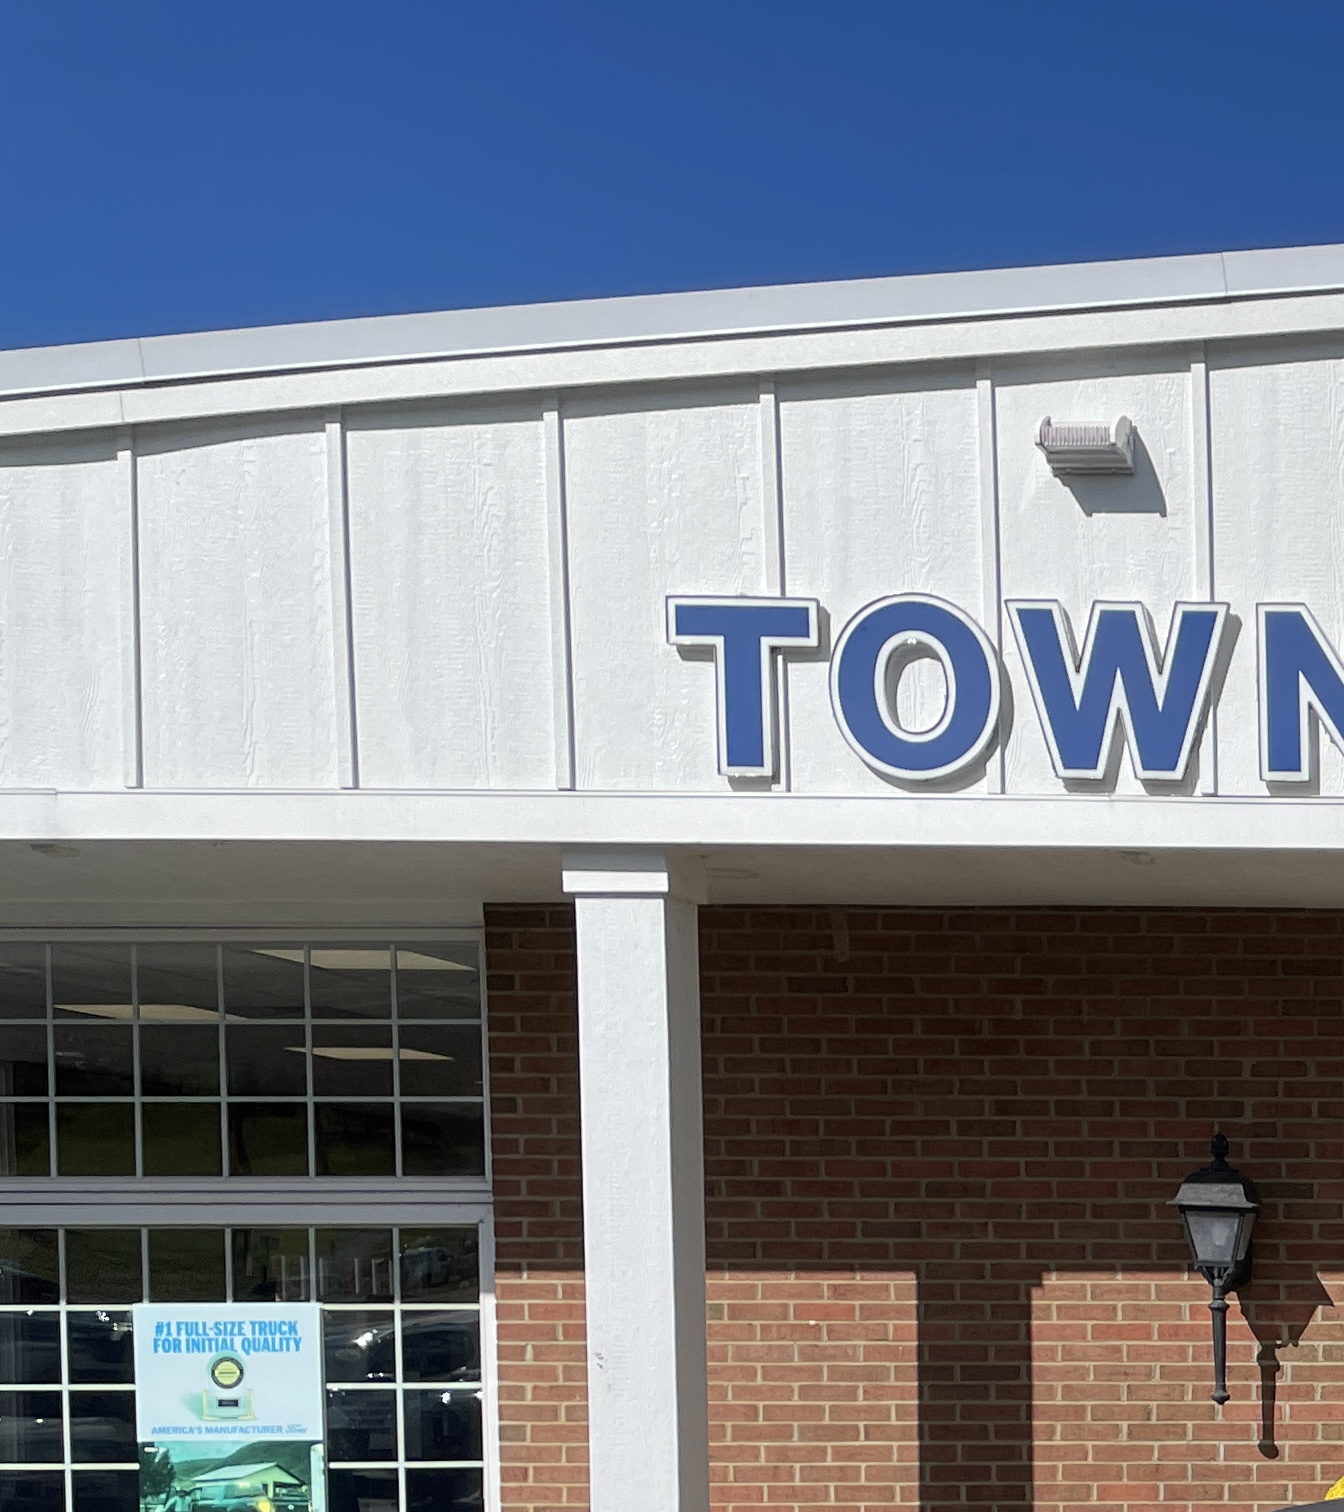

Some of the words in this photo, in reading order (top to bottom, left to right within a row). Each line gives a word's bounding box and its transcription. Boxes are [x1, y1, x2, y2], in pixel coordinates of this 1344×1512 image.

[155, 1321, 173, 1337] #1
[176, 1321, 246, 1337] FULL-SIZE
[250, 1321, 299, 1336] TRUCK
[153, 1338, 182, 1353] FOR
[186, 1337, 237, 1353] INITIAL
[241, 1337, 303, 1356] QUALITY
[151, 1426, 203, 1435] AMERICA'S
[205, 1425, 283, 1434] MANUFACTURER
